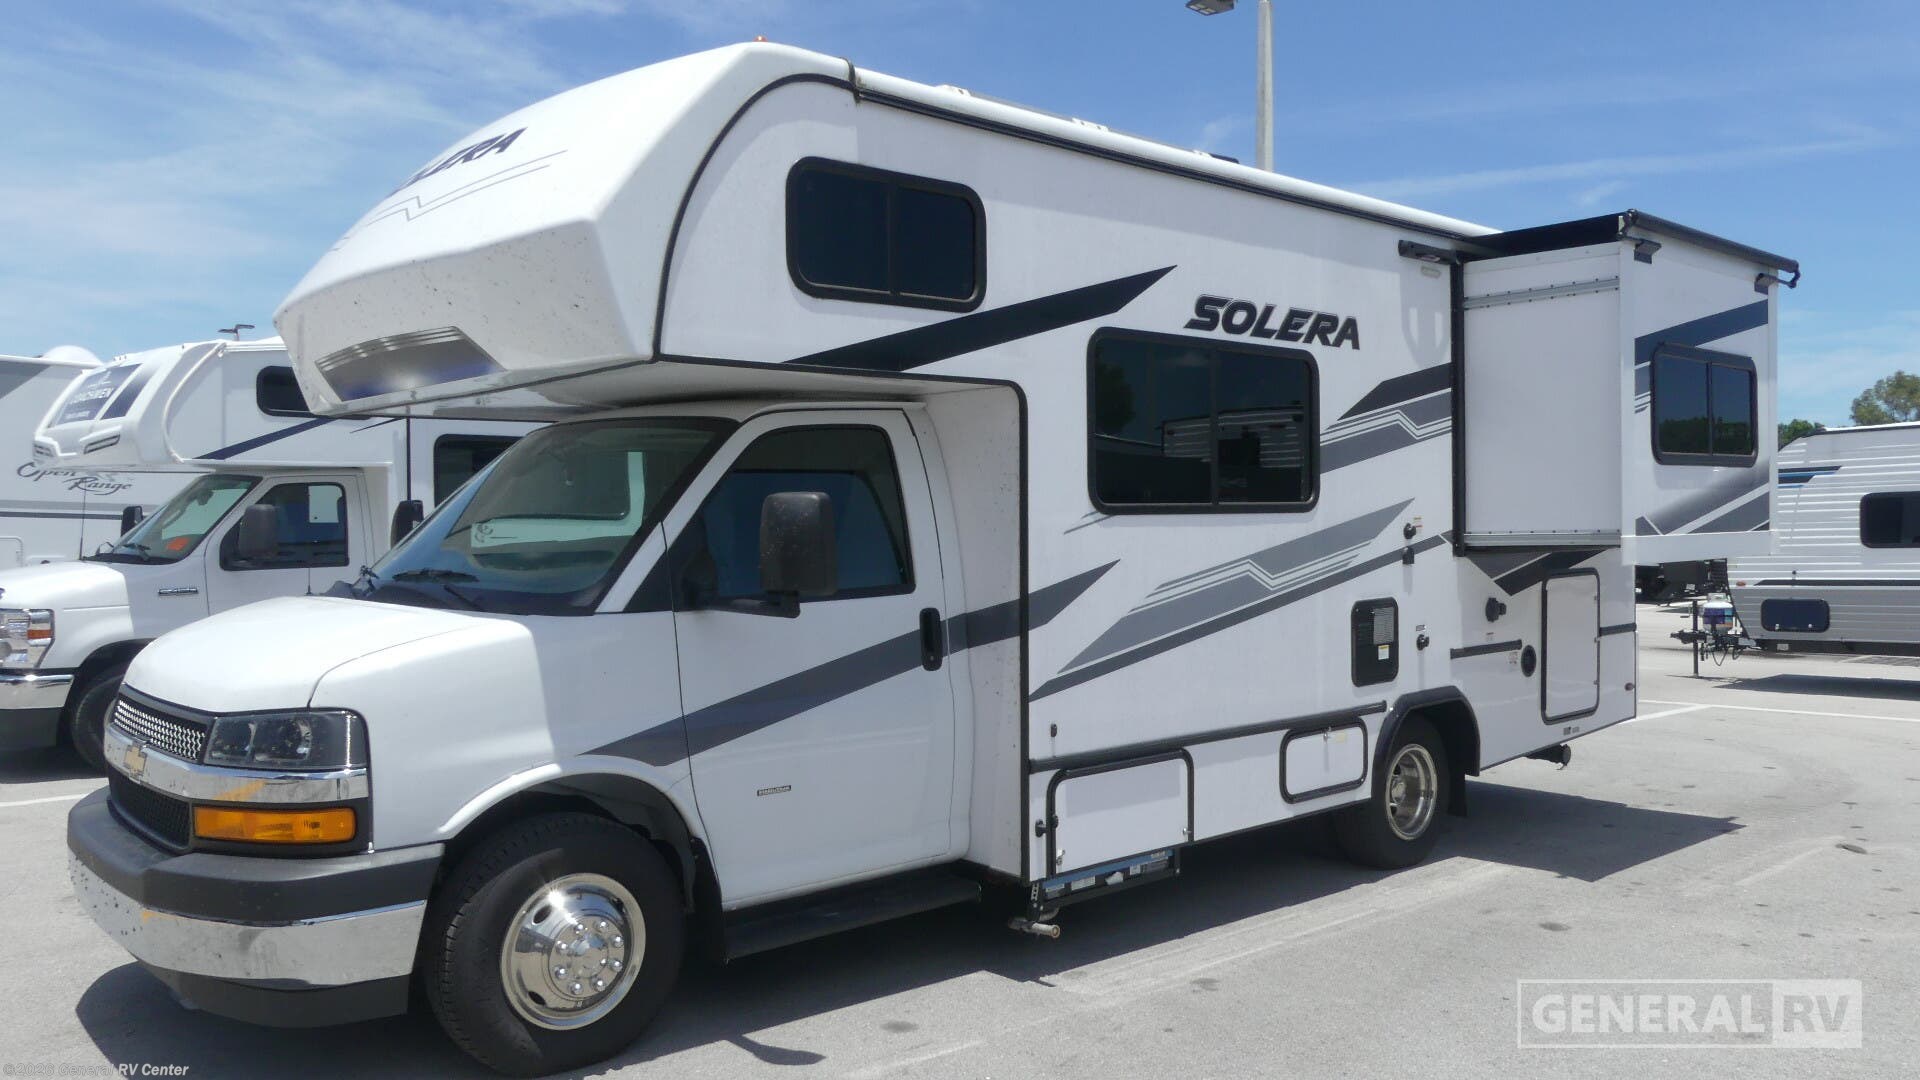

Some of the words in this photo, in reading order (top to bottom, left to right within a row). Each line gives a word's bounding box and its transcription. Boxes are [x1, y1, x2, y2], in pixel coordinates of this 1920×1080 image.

[385, 127, 528, 199] OLERA
[1184, 293, 1360, 350] SOLERA
[17, 462, 76, 481] Open
[63, 476, 132, 495] Range
